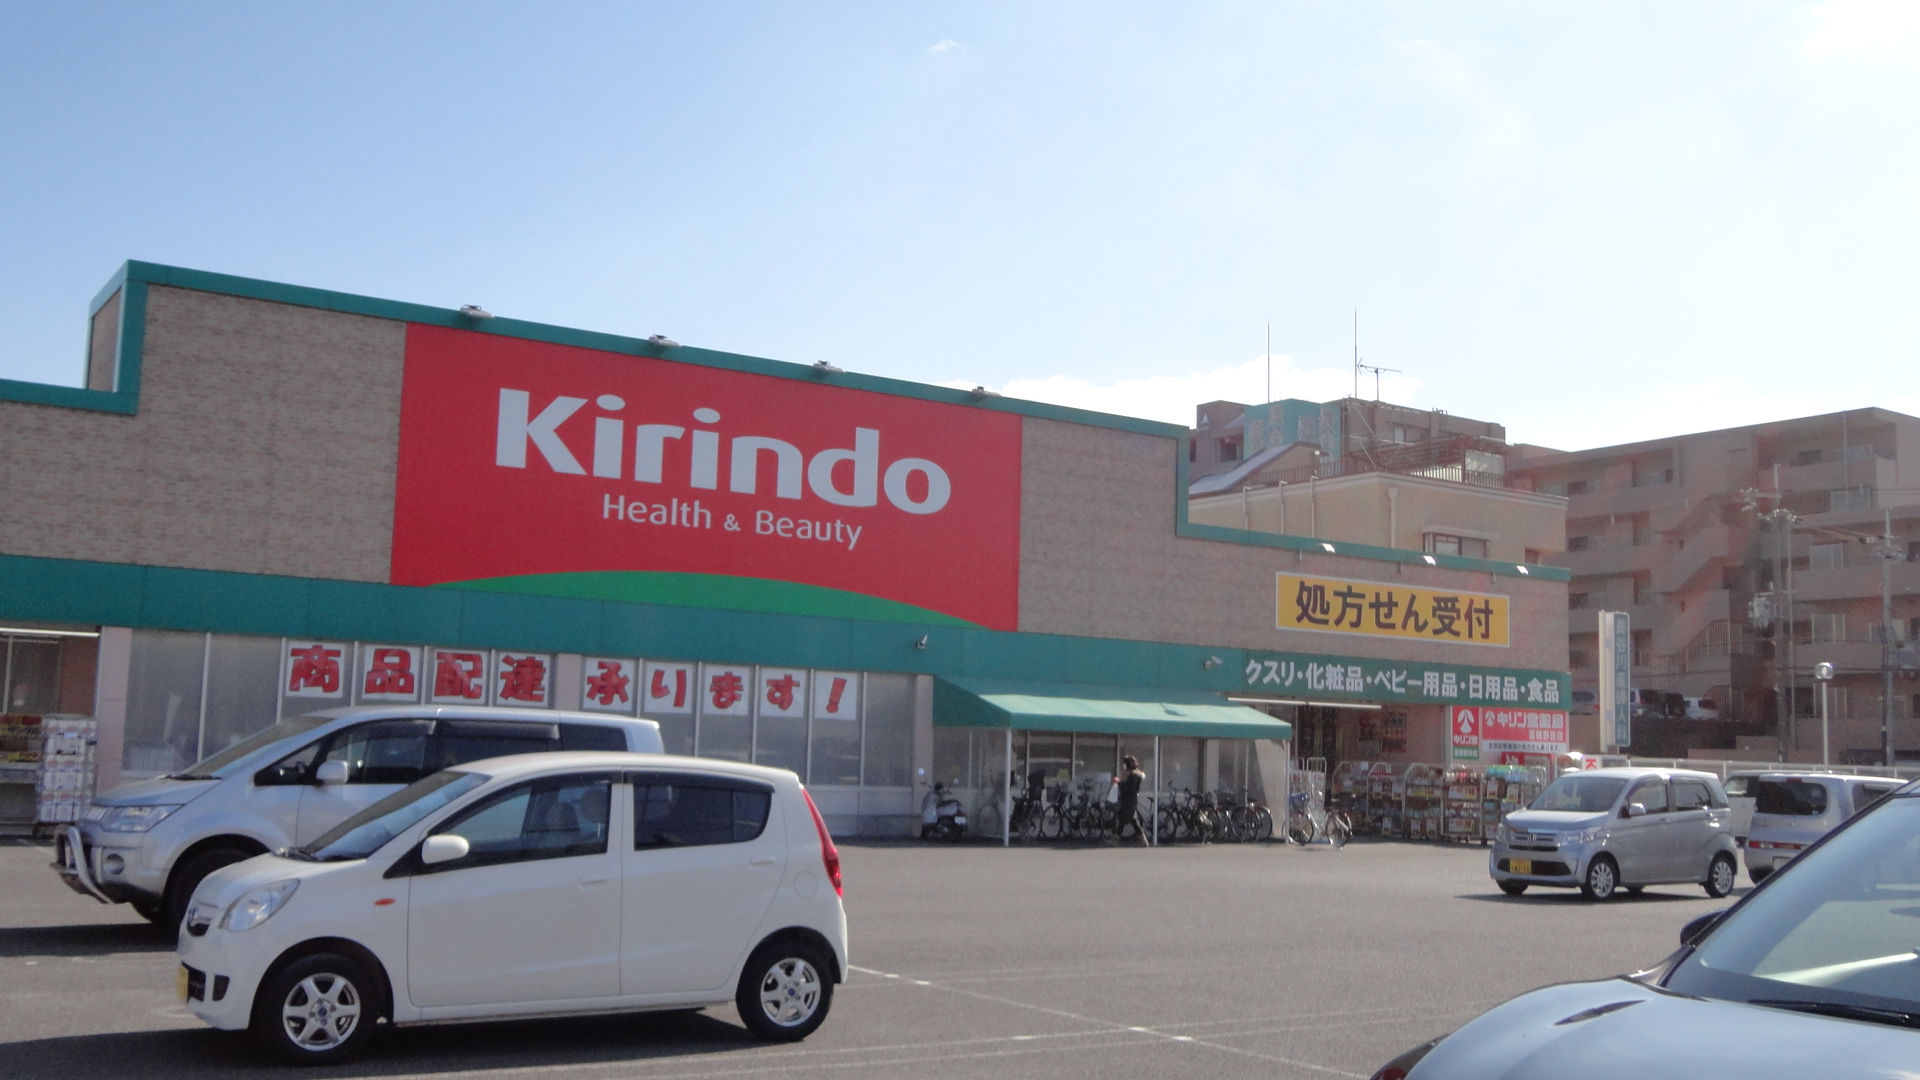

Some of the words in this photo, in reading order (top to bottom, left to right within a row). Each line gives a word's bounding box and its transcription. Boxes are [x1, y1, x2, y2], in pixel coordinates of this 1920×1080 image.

[495, 388, 952, 515] Kirindo
[602, 493, 712, 530] Health
[723, 513, 741, 532] &
[755, 509, 863, 550] Beauty
[1295, 580, 1494, 640] 処方せん受付
[289, 644, 546, 703] 商品配達
